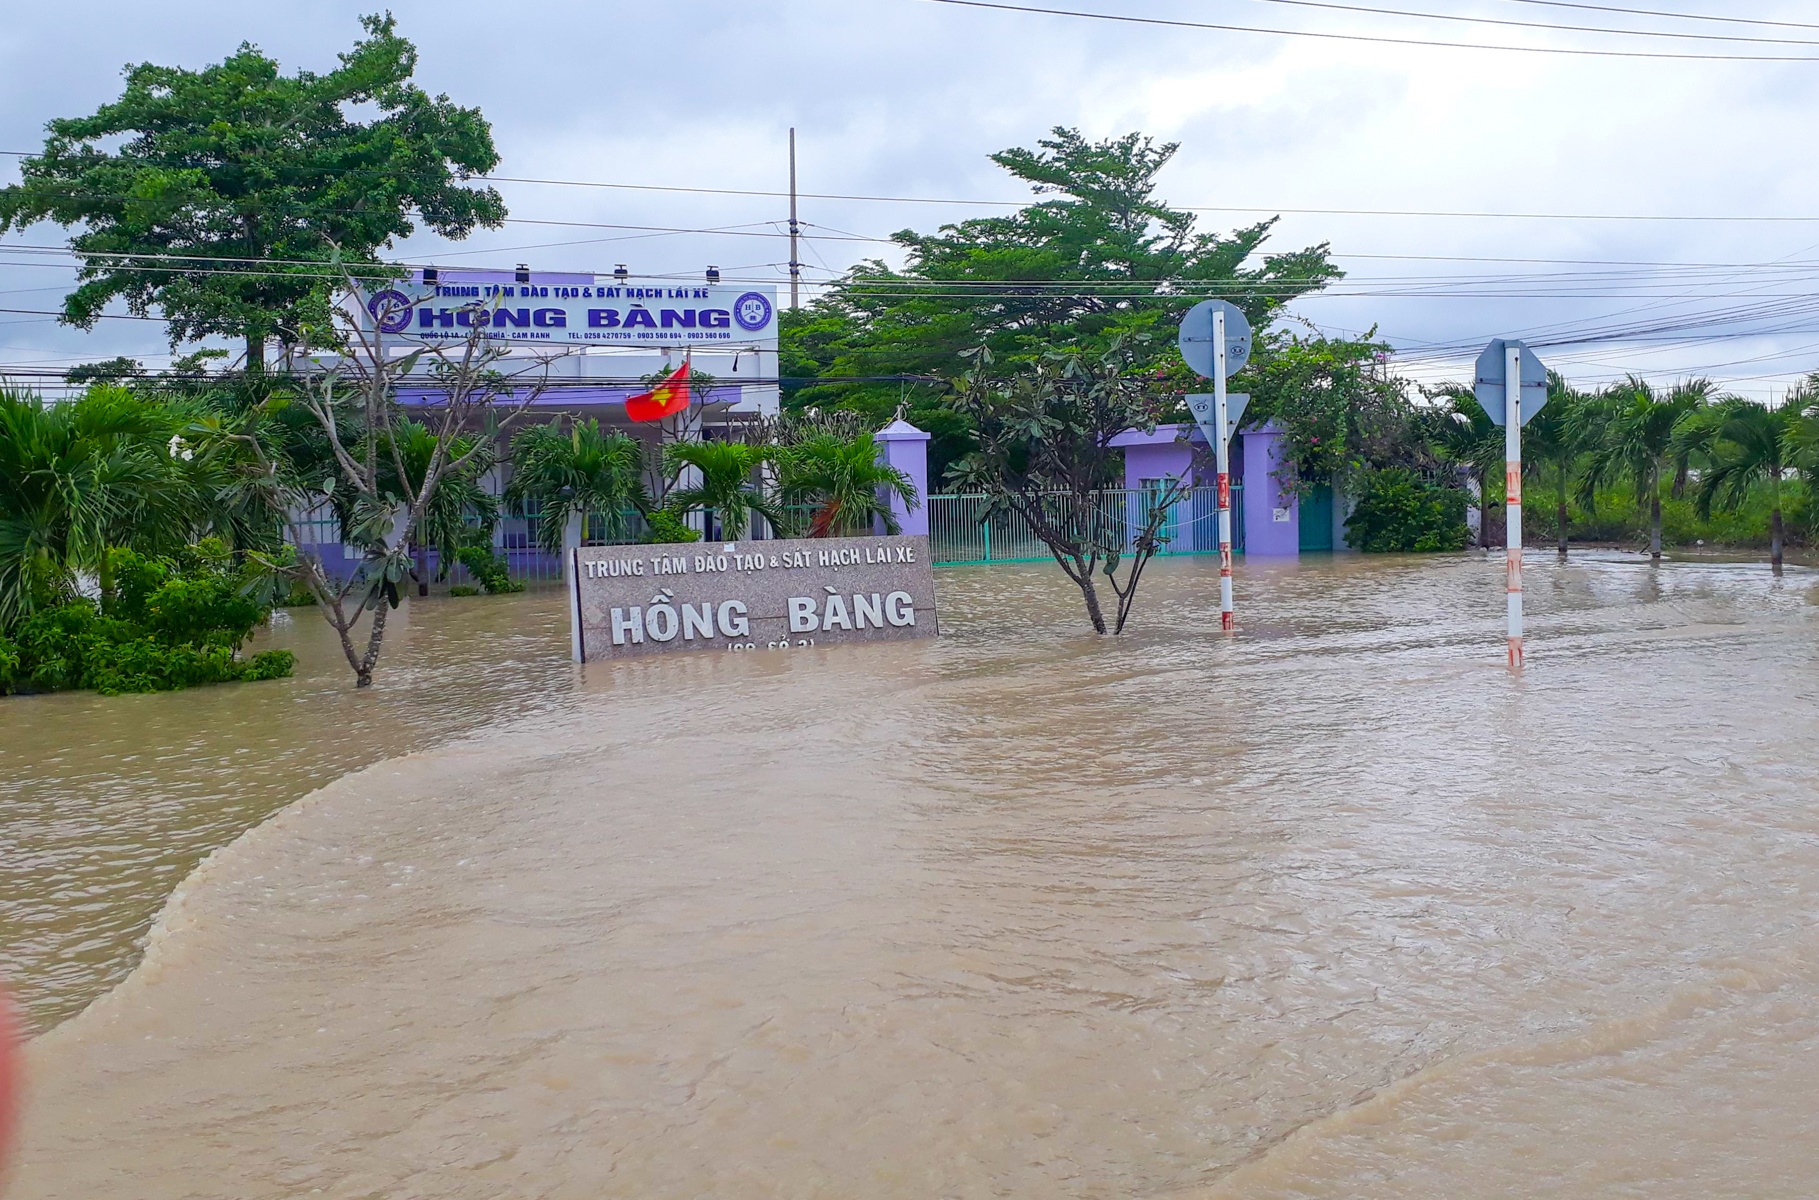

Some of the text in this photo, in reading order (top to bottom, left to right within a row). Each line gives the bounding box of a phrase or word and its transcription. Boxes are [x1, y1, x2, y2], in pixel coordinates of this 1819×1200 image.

[435, 284, 709, 300] TRUNG TÂM ĐÀO TẠO & SÁT HẠCH LÁI XE
[587, 303, 730, 328] BÀNG
[669, 332, 682, 340] 694
[687, 332, 704, 340] 0903
[718, 332, 731, 340] 696
[585, 542, 916, 579] TRUNG TÂM ĐÀO TẠO & SÁT HẠCH LÁI XE
[610, 585, 915, 645] HỒNG BÀNG
